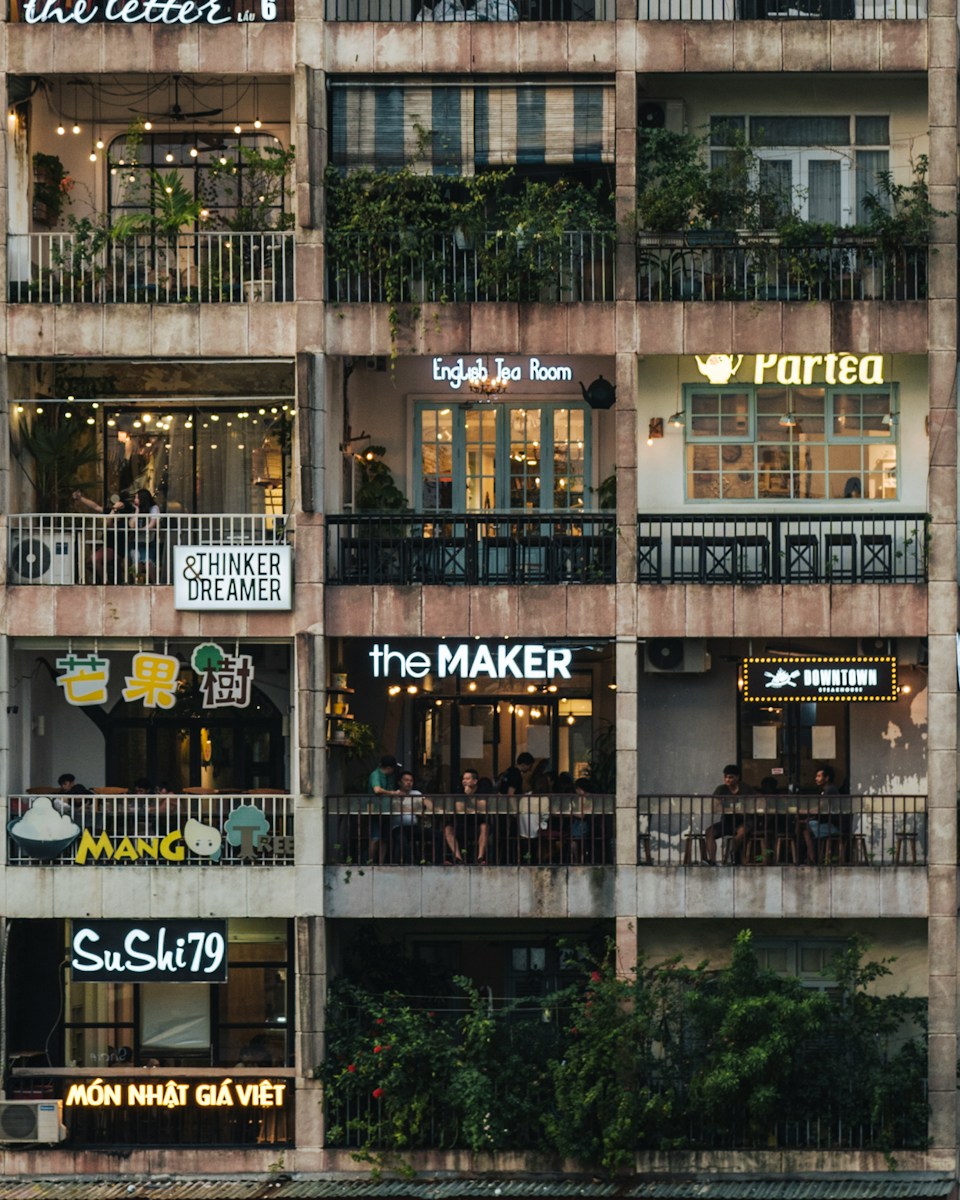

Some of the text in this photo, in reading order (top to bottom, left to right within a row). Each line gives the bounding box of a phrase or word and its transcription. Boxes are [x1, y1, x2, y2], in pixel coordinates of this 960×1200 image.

[495, 357, 522, 381] Tea
[530, 357, 572, 381] Room
[196, 553, 281, 575] THINKER
[188, 578, 281, 601] DREAMER
[369, 644, 572, 679] the MAKER
[56, 645, 254, 709] 芒果樹
[803, 669, 878, 686] DOWNTOWN
[66, 1078, 122, 1106] MÓN
[195, 1078, 234, 1106] GIÁ
